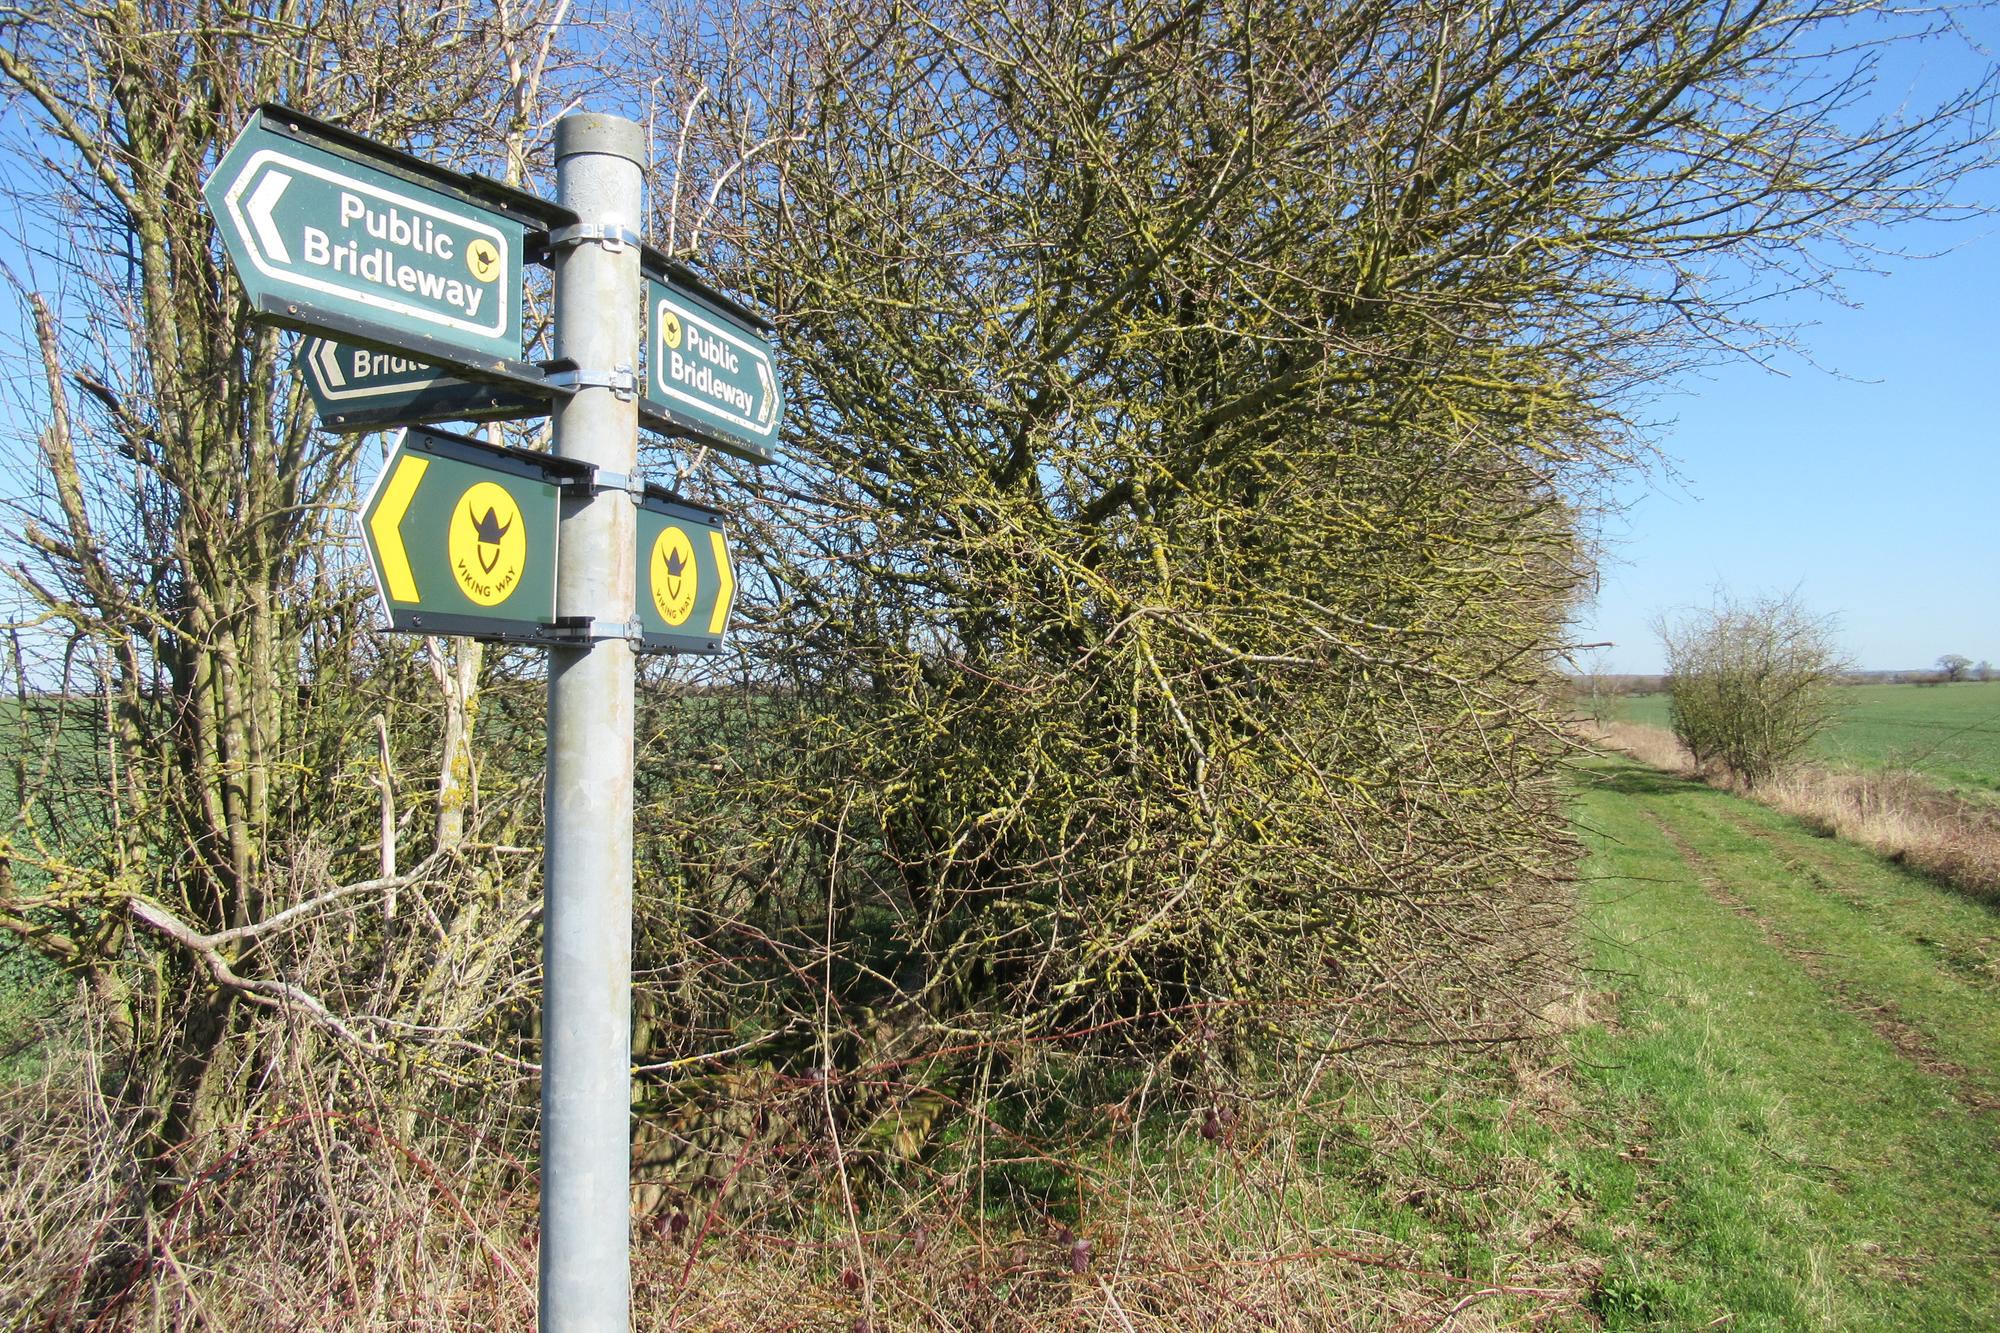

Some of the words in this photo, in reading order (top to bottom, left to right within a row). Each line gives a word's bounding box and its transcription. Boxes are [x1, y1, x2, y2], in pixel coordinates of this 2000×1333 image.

[341, 191, 454, 260] Public
[303, 225, 484, 317] Bridleway
[687, 324, 739, 374] Public
[671, 351, 753, 416] Bridleway
[458, 558, 491, 597] VIKING
[495, 565, 516, 593] WAY
[656, 587, 677, 619] VIKING
[679, 593, 691, 615] WAY
